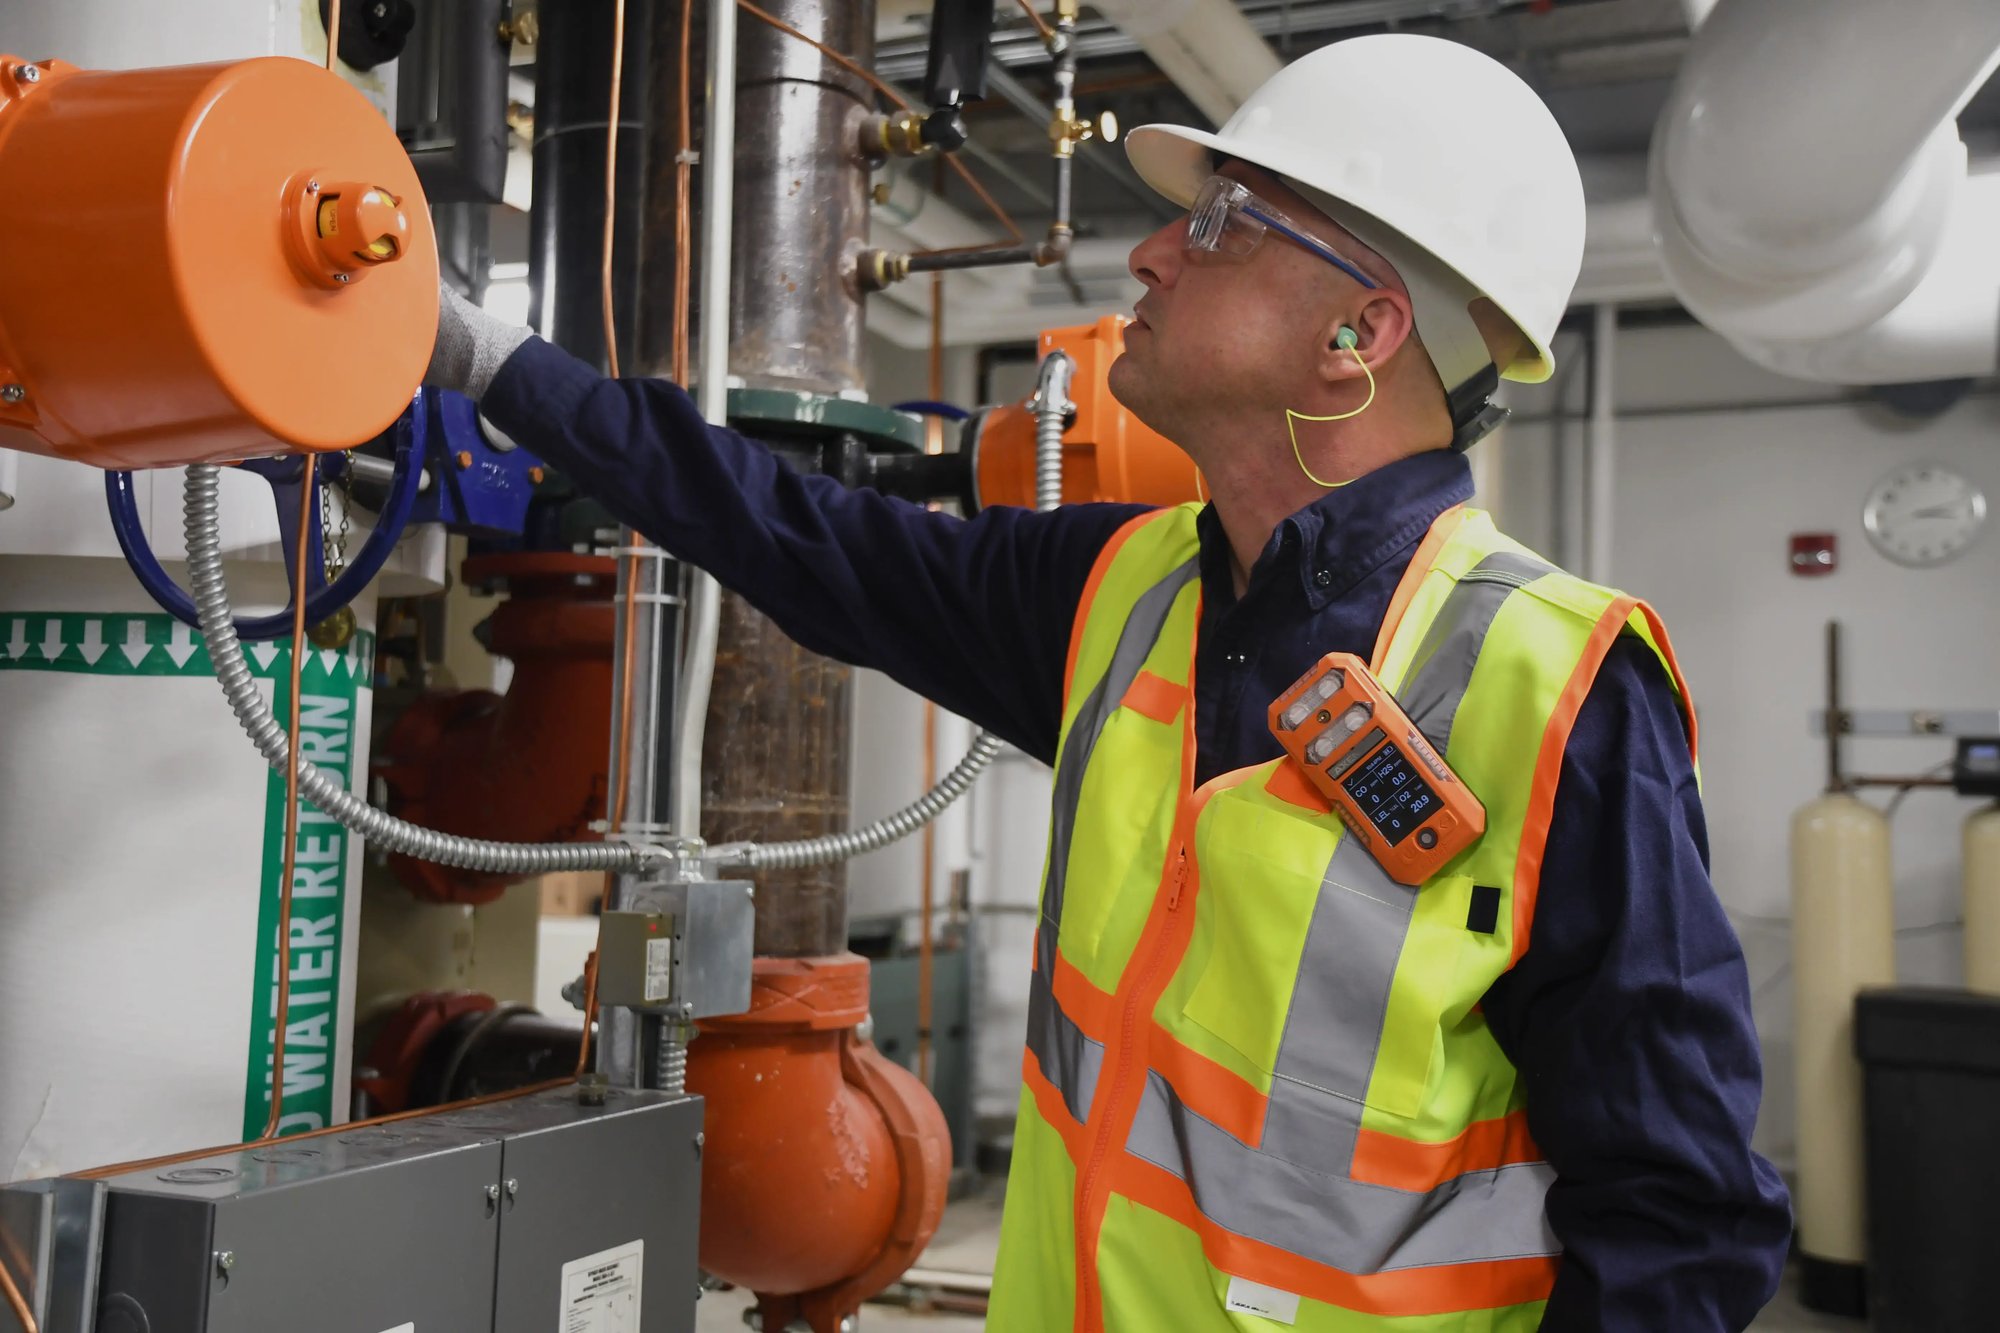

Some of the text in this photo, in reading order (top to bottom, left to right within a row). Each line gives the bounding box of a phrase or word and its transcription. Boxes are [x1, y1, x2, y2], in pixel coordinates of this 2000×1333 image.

[1378, 763, 1393, 778] H2S
[1392, 772, 1406, 786] 0.0
[1355, 786, 1368, 798] CO
[1399, 791, 1411, 803] O2
[1371, 794, 1380, 803] 0
[1410, 794, 1430, 813] 20.9
[1375, 811, 1391, 823] LEL
[1391, 819, 1400, 828] 0
[264, 914, 336, 1101] WATER
